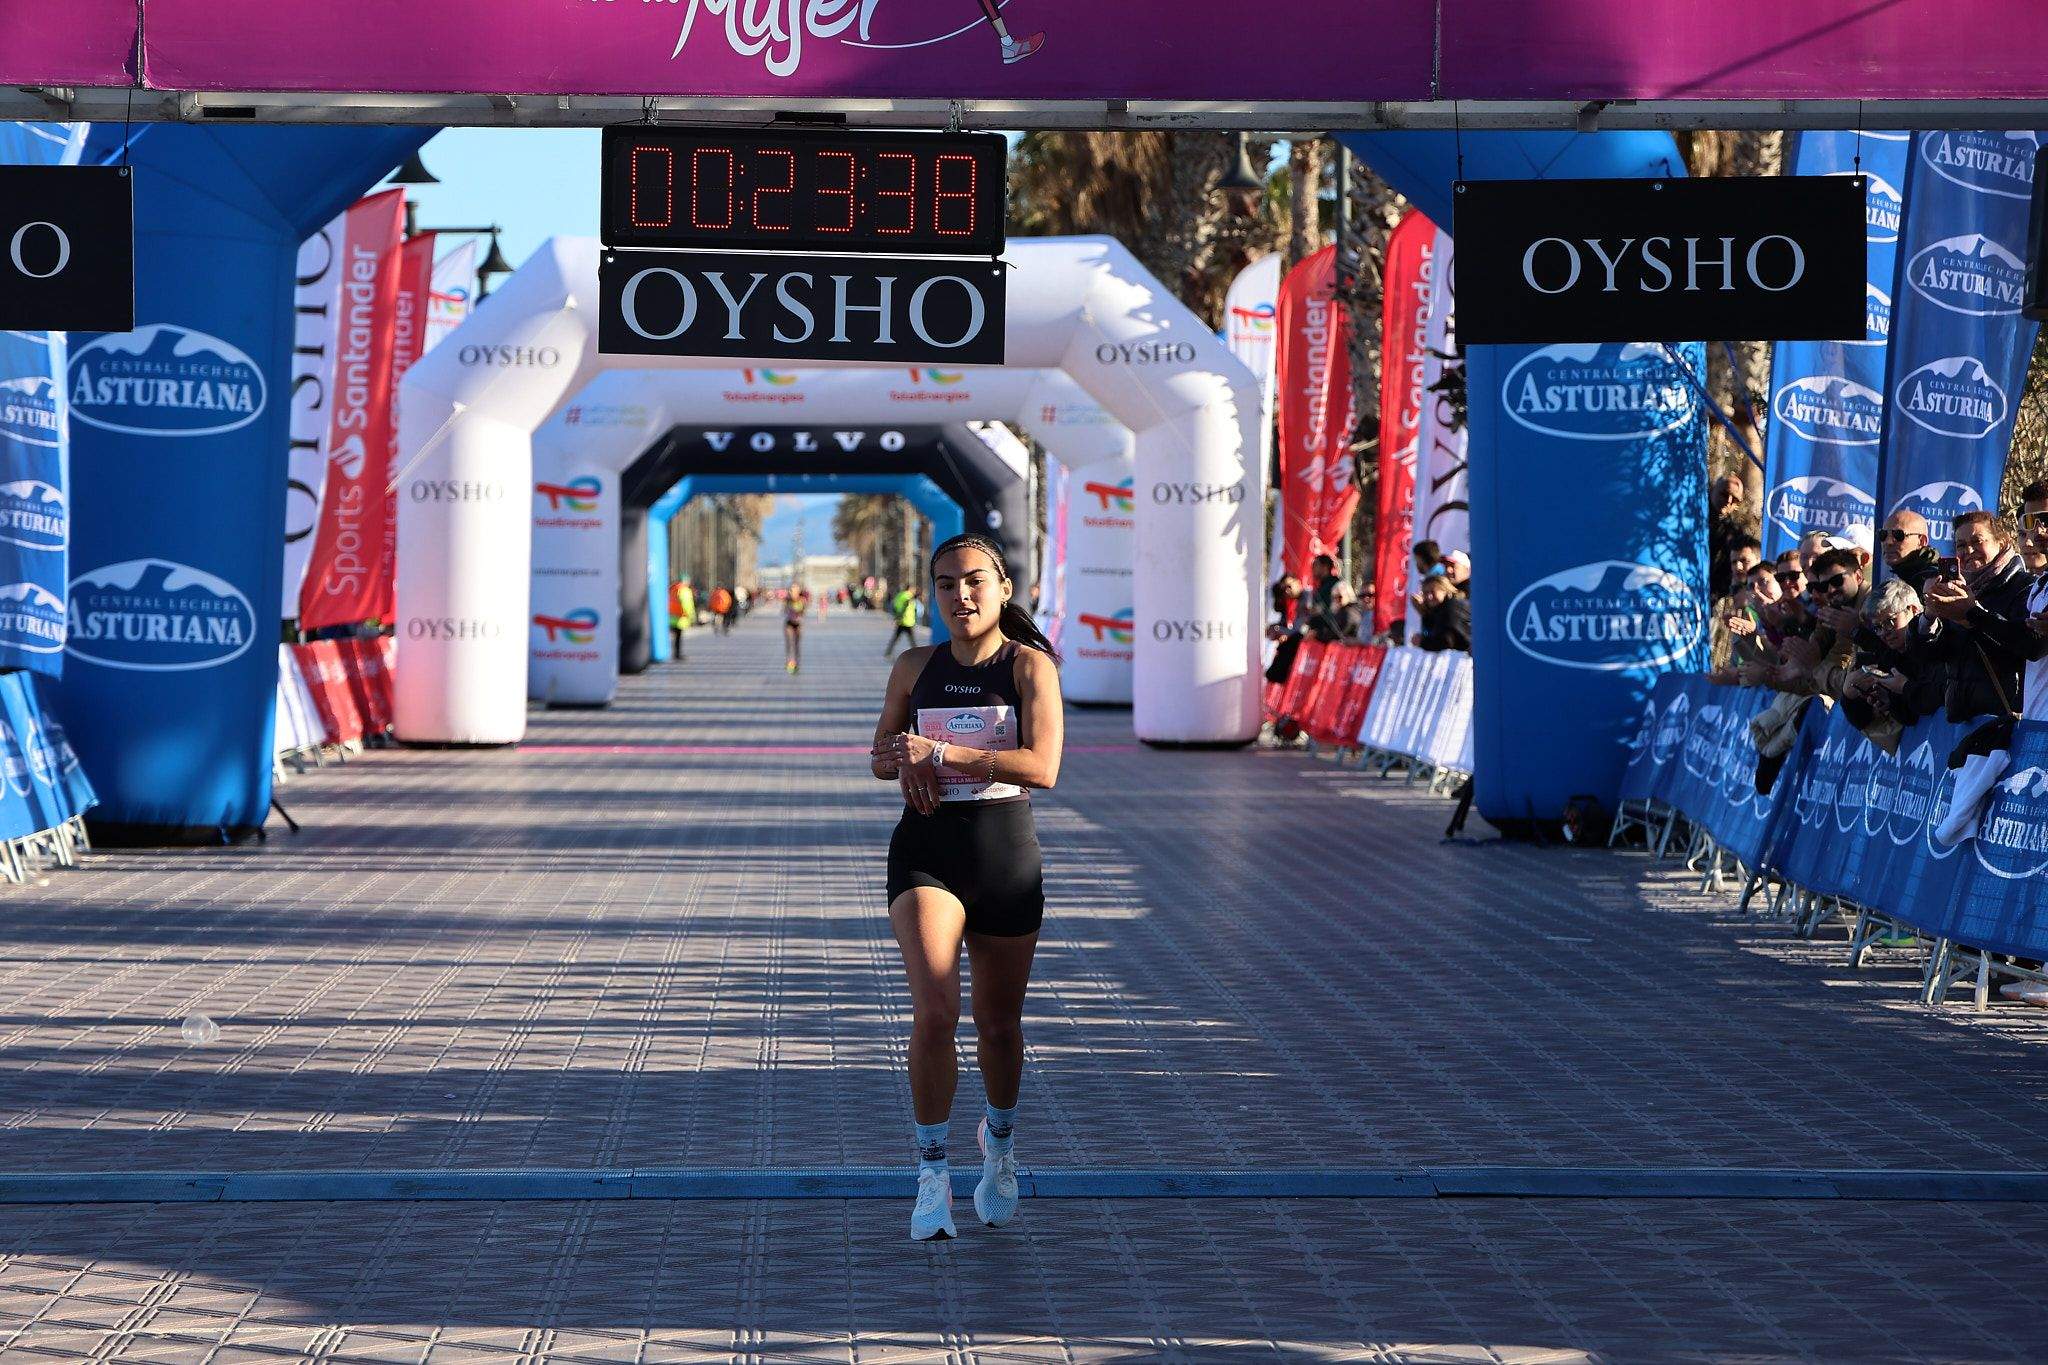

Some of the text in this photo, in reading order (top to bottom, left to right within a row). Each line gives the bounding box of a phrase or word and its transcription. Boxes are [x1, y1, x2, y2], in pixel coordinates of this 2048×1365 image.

[631, 146, 976, 236] 00:23:38
[1522, 234, 1806, 295] OYSHO
[621, 266, 986, 349] OYSHO
[458, 344, 561, 368] OYSHO
[1096, 342, 1197, 366] OYSHO
[70, 363, 255, 413] ASTURIANA
[326, 243, 379, 597] Sports Santander
[702, 430, 906, 452] VOLVO
[411, 479, 504, 503] OYSHO
[1152, 482, 1246, 506] OYSHO
[66, 597, 243, 646] ASTURIANA
[944, 684, 981, 695] OYSHO
[949, 722, 984, 731] ASTURIANA
